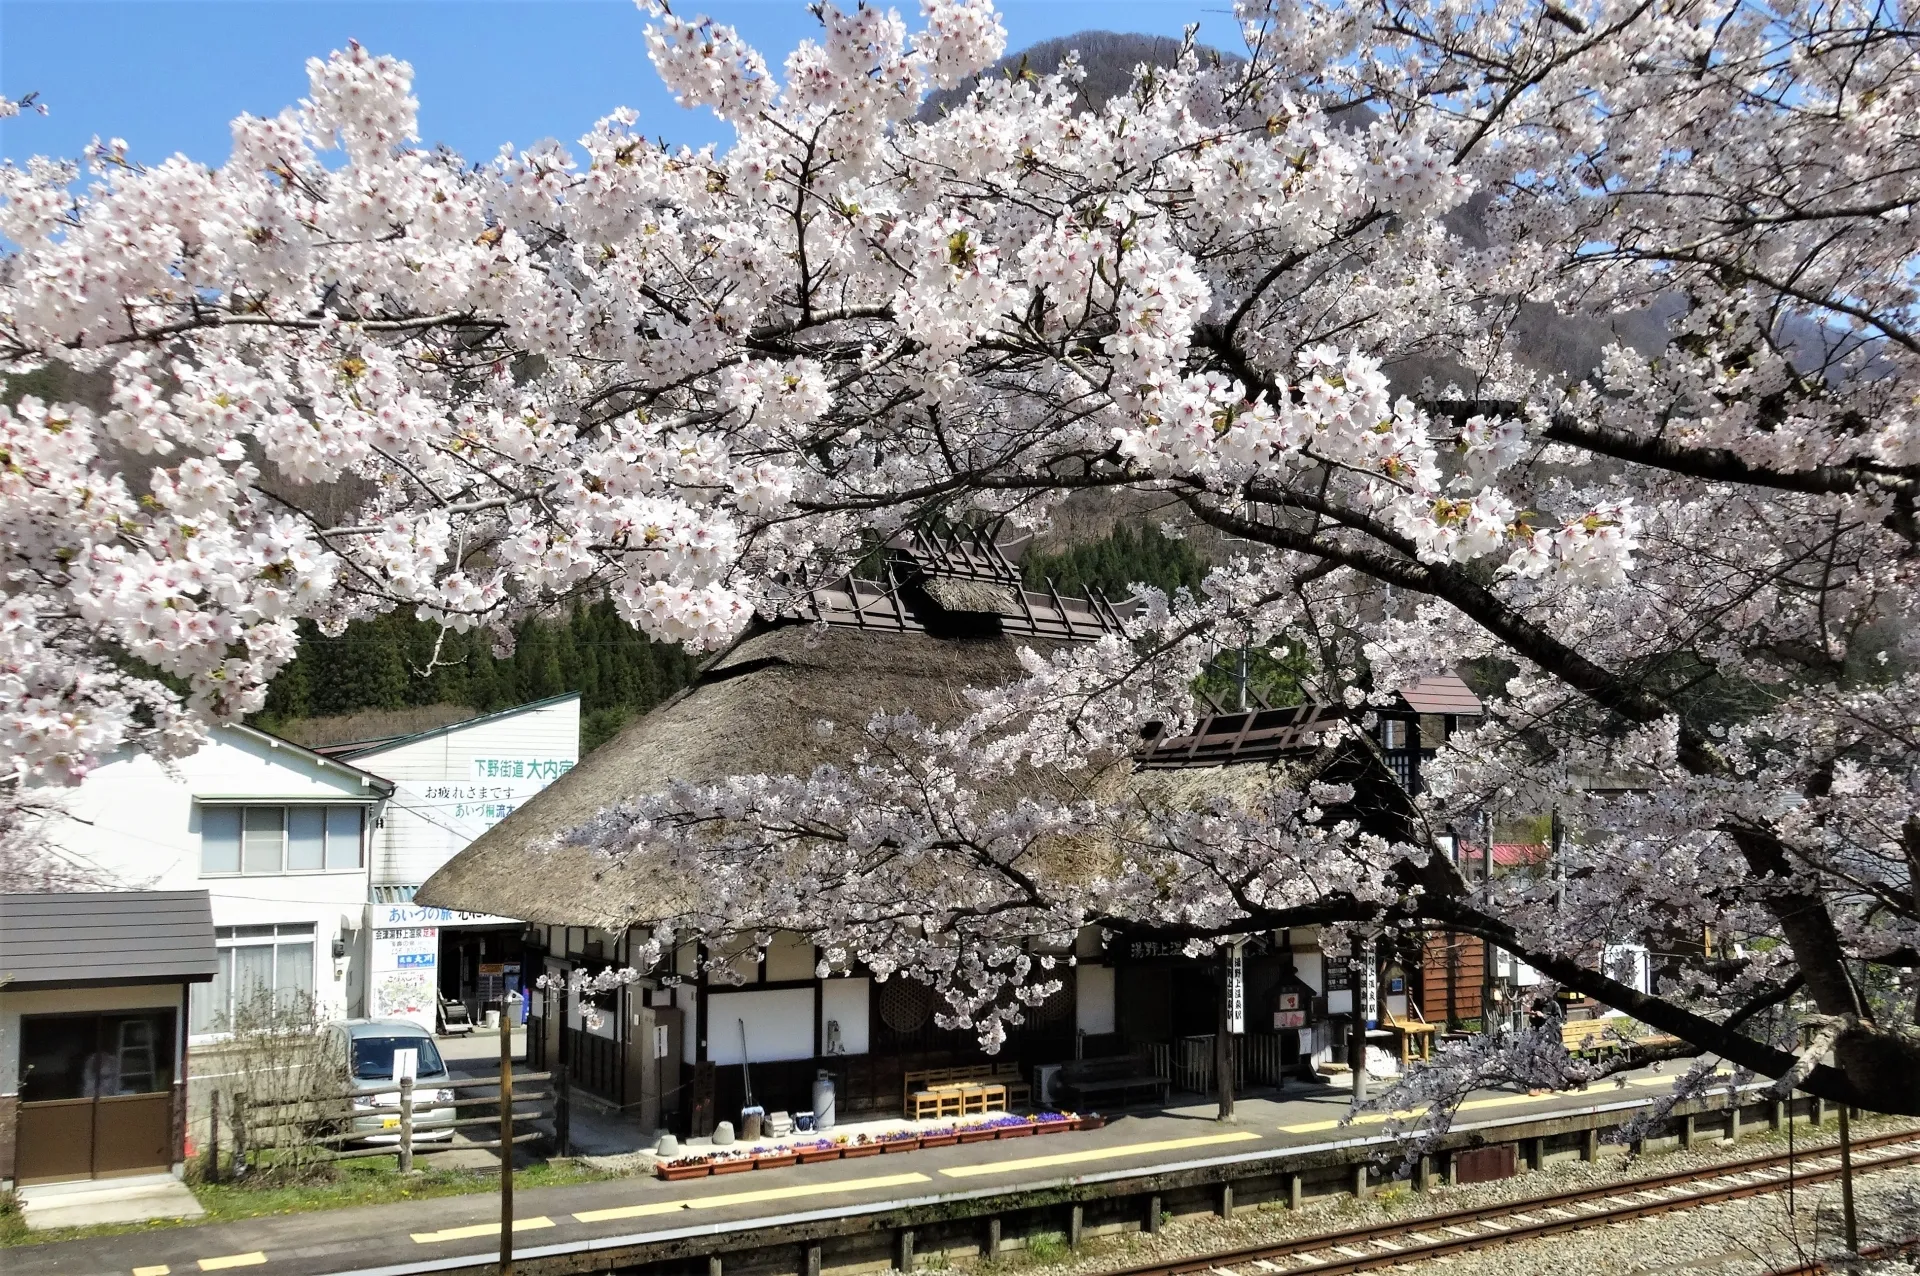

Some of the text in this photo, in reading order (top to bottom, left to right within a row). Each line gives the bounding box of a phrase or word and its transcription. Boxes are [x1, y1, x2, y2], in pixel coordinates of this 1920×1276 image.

[425, 786, 515, 799] お疲れさまです
[389, 907, 453, 922] あいづの旅
[1234, 957, 1242, 1020] 湯野上温泉駅
